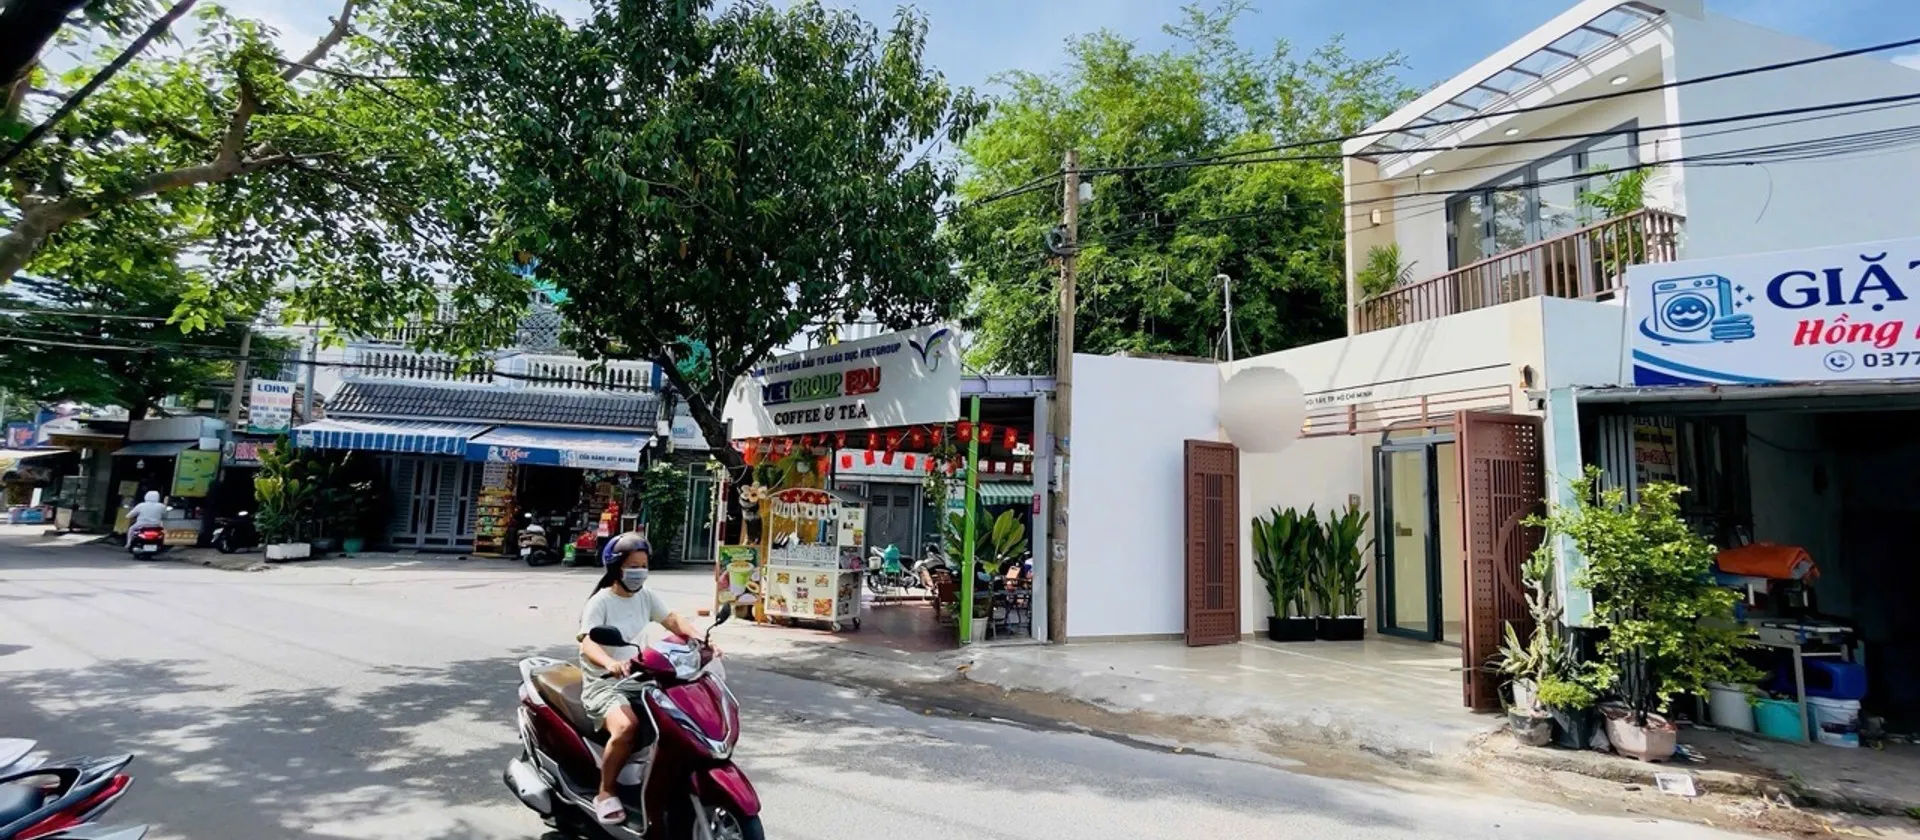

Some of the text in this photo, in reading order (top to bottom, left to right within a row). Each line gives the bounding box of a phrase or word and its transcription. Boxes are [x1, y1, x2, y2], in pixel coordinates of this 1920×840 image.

[1766, 252, 1920, 312] GIẶ
[1794, 313, 1904, 349] Hồng
[826, 353, 843, 364] GIÁO
[762, 366, 881, 403] VIETGROUP EDU
[774, 404, 868, 425] COFFEE & TEA
[501, 447, 531, 462] Tiger
